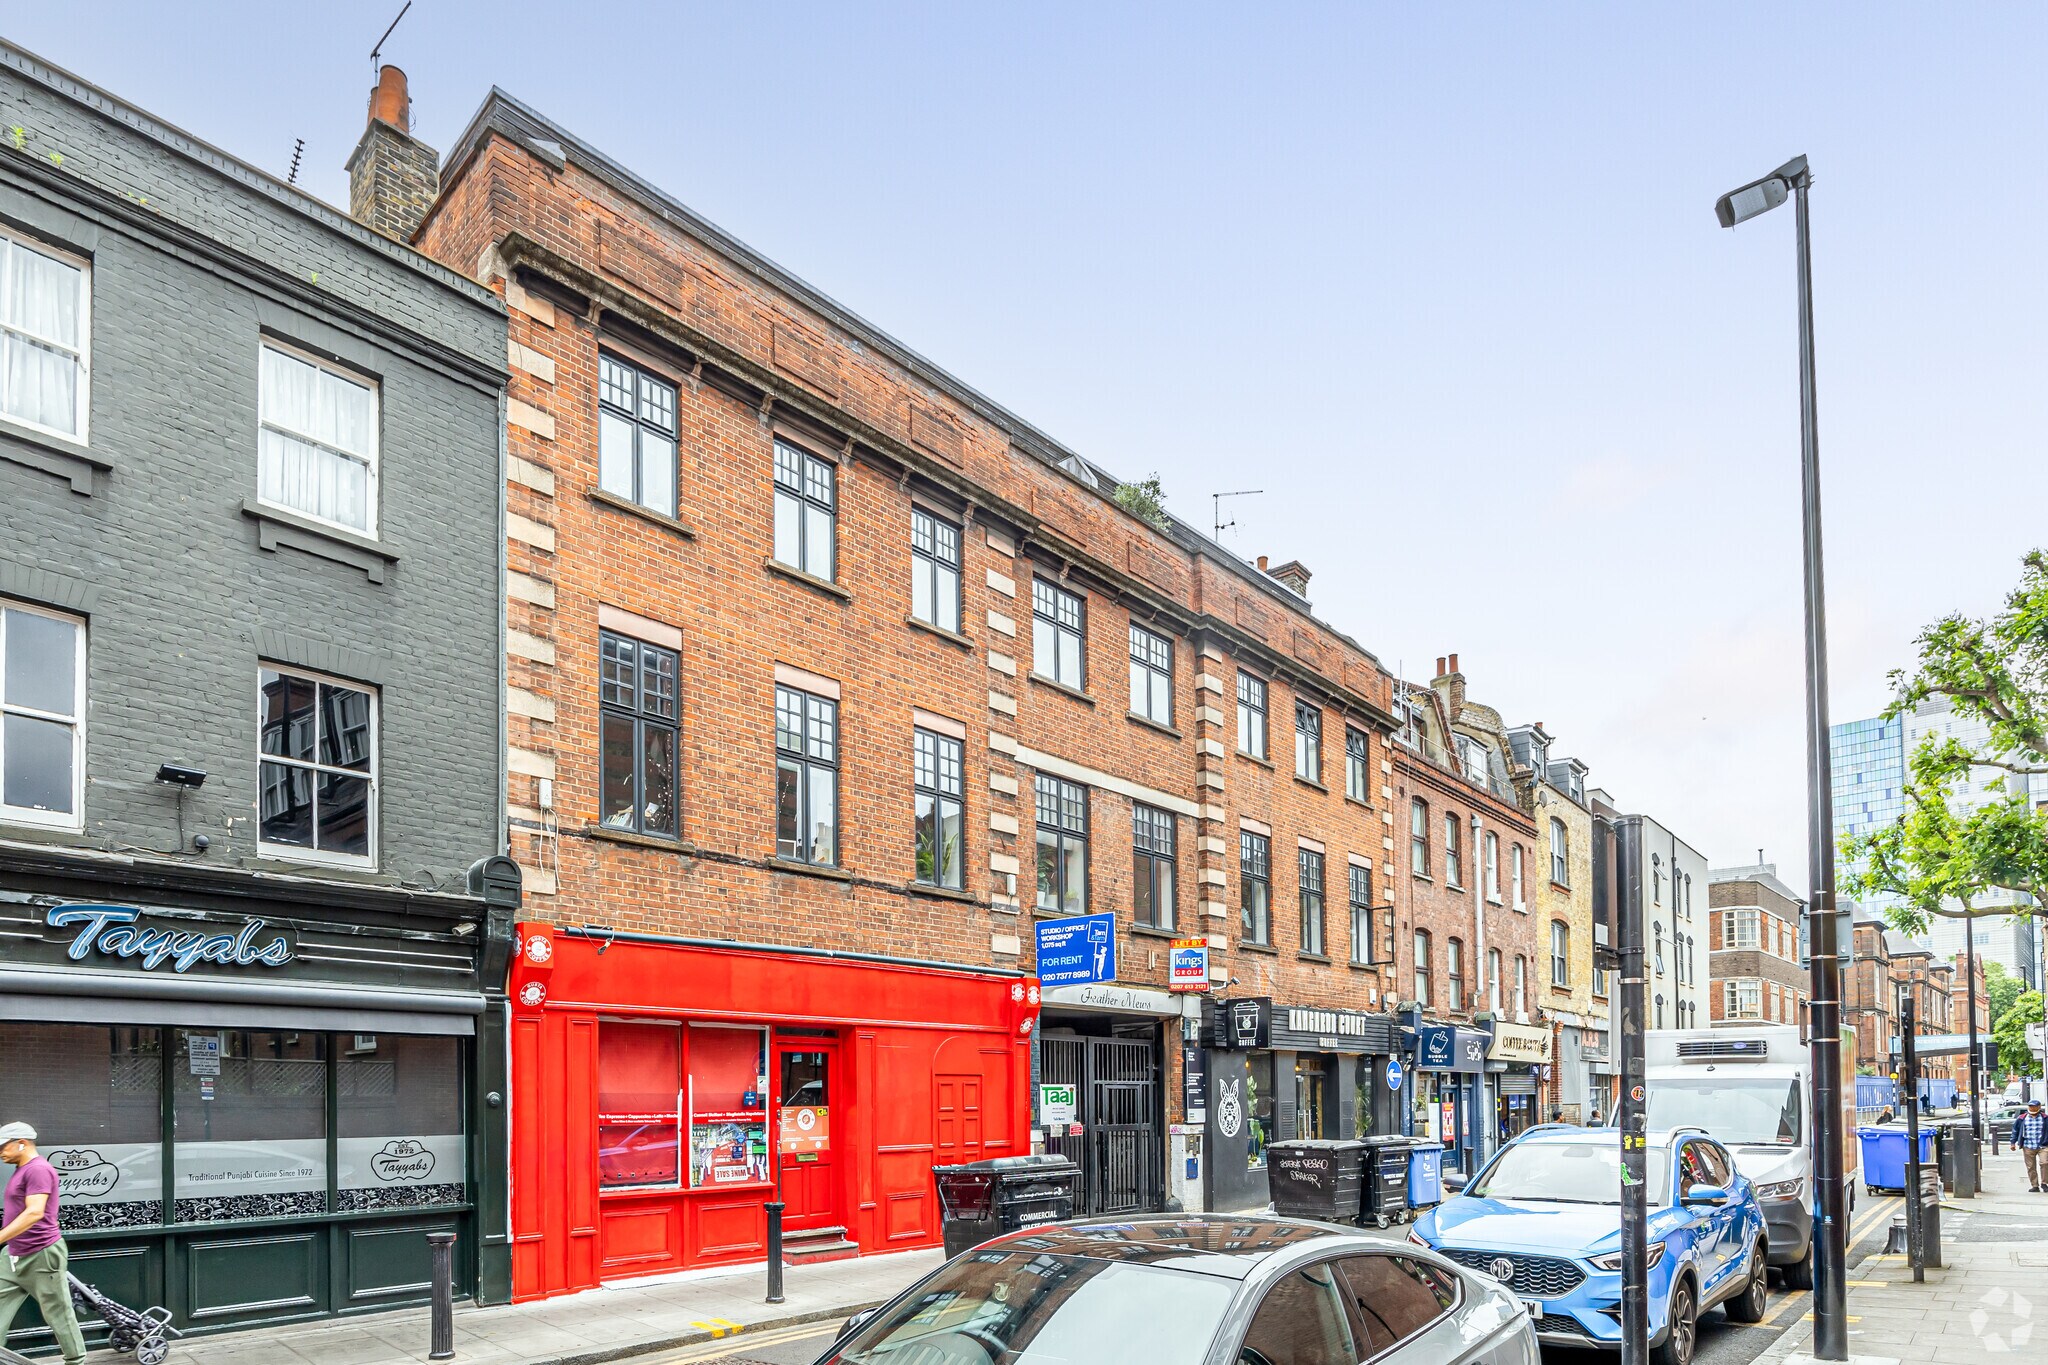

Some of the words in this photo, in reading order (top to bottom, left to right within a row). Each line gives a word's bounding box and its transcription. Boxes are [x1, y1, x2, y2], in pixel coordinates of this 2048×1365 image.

[47, 904, 293, 973] Tayyabs
[1041, 933, 1073, 941] WORKSHOP
[1042, 958, 1059, 967] FOR
[1060, 955, 1083, 965] RENT
[1175, 954, 1202, 968] kings
[1042, 973, 1055, 981] 020
[1056, 972, 1072, 980] 7377
[1072, 970, 1090, 979] 8989
[1080, 987, 1118, 1006] Feather
[1121, 991, 1151, 1009] Mews
[1288, 1009, 1336, 1034] KANGAROO
[1338, 1014, 1366, 1036] COURT
[1319, 1037, 1338, 1048] COFFEE
[1042, 1087, 1074, 1106] Taaj
[380, 1158, 428, 1174] Tayyabs
[188, 1172, 225, 1181] Traditional
[227, 1171, 252, 1180] Punjabi
[254, 1170, 277, 1178] Cuisine
[279, 1169, 295, 1177] Since
[297, 1168, 313, 1176] 1972
[716, 1170, 730, 1178] SALE
[731, 1169, 747, 1177] WINE
[1020, 1210, 1057, 1221] COMMERCIAL
[1492, 1261, 1512, 1279] MG
